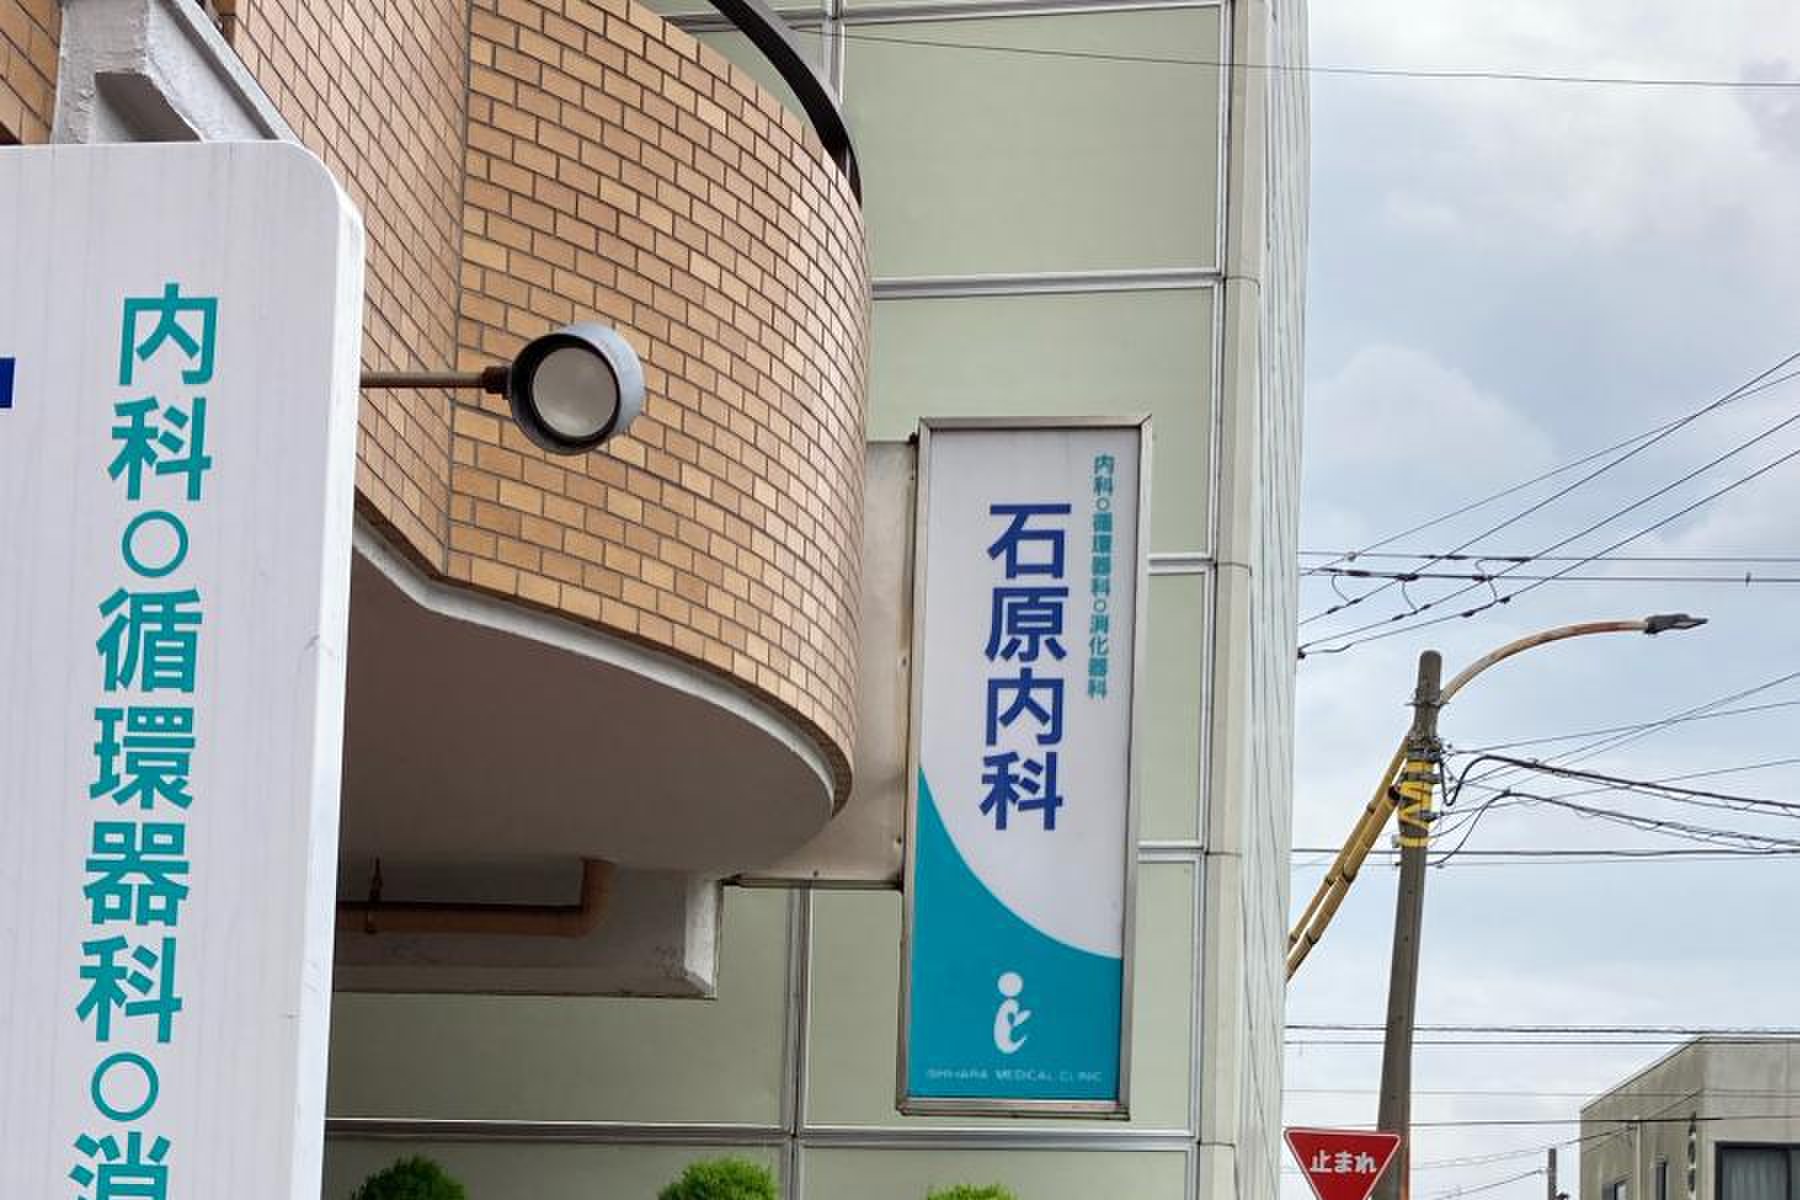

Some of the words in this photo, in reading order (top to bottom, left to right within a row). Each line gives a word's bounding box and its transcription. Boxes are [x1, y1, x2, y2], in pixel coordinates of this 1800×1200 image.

[979, 503, 1071, 831] 石原内科
[995, 1069, 1053, 1082] MEDICAL
[1059, 1071, 1103, 1083] CLINIC
[1310, 1149, 1378, 1174] 止まれ
